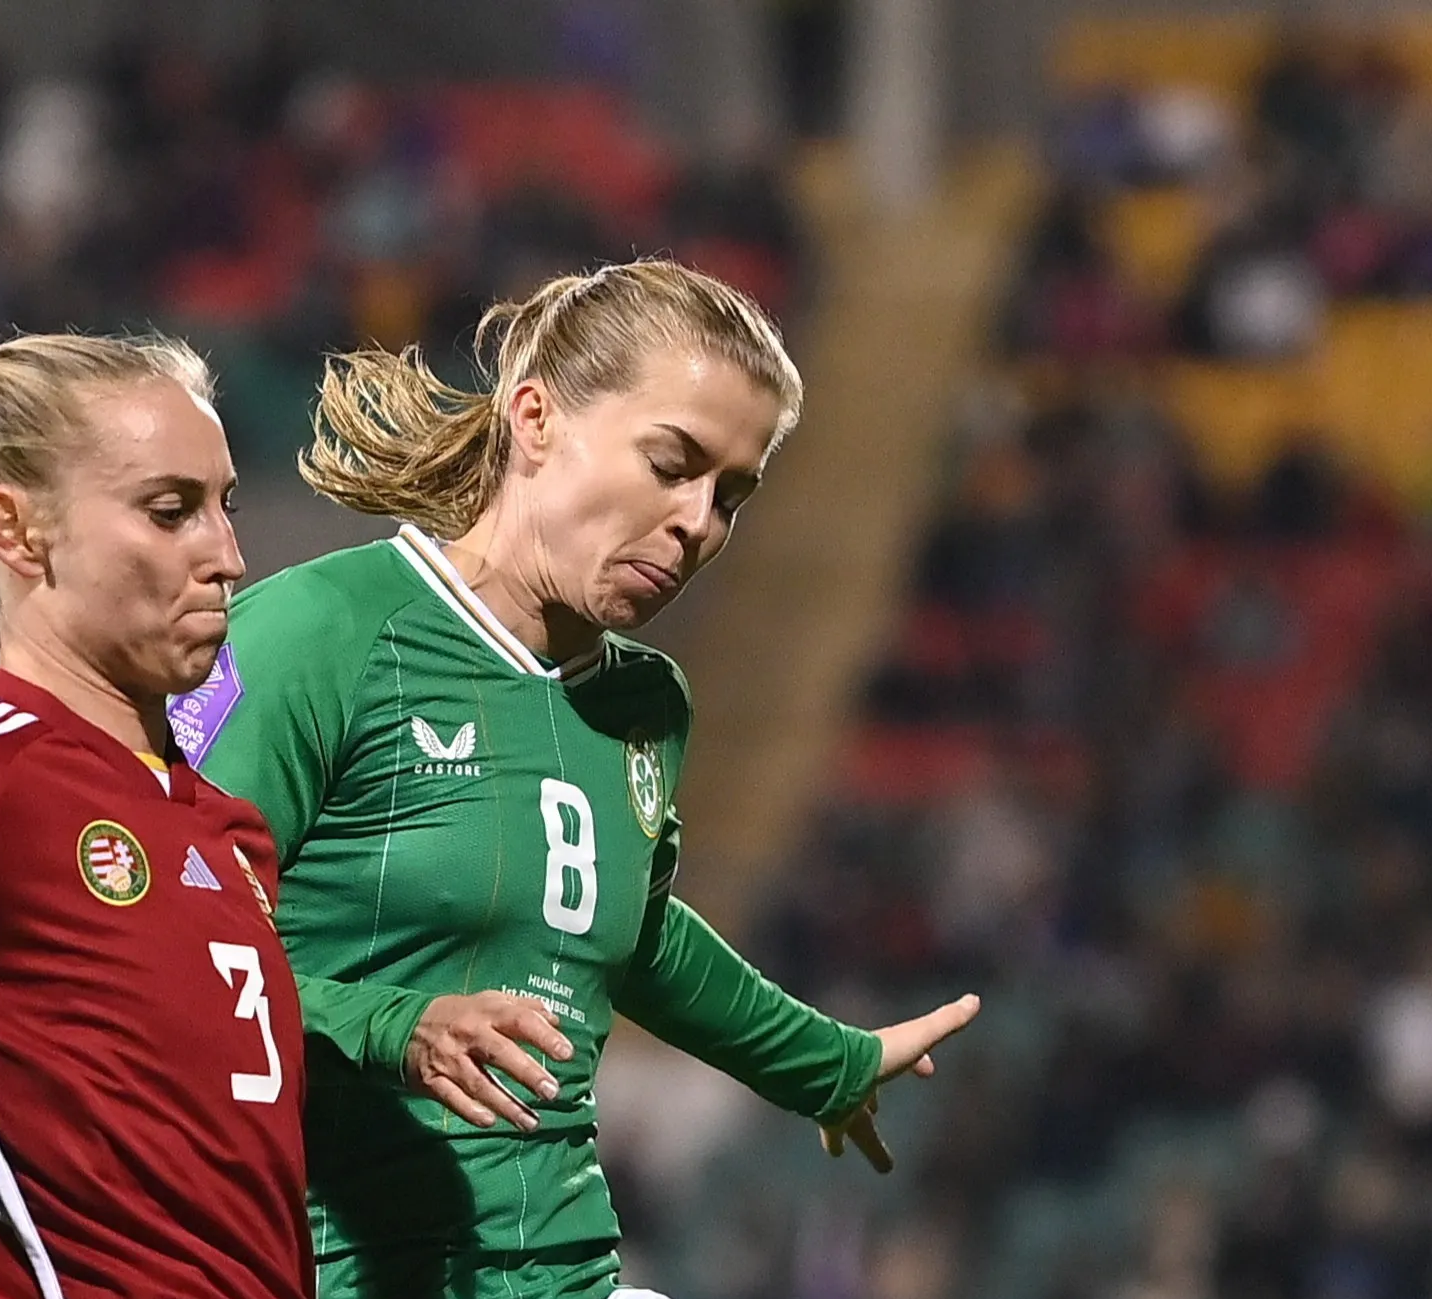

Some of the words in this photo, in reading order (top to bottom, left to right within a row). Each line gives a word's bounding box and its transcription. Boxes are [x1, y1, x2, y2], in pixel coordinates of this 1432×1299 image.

[167, 715, 206, 744] ATIONS
[174, 734, 200, 755] GUE
[414, 763, 481, 777] CASTORE
[540, 777, 598, 935] 8
[528, 973, 574, 999] HUNGARY
[208, 941, 282, 1104] 3
